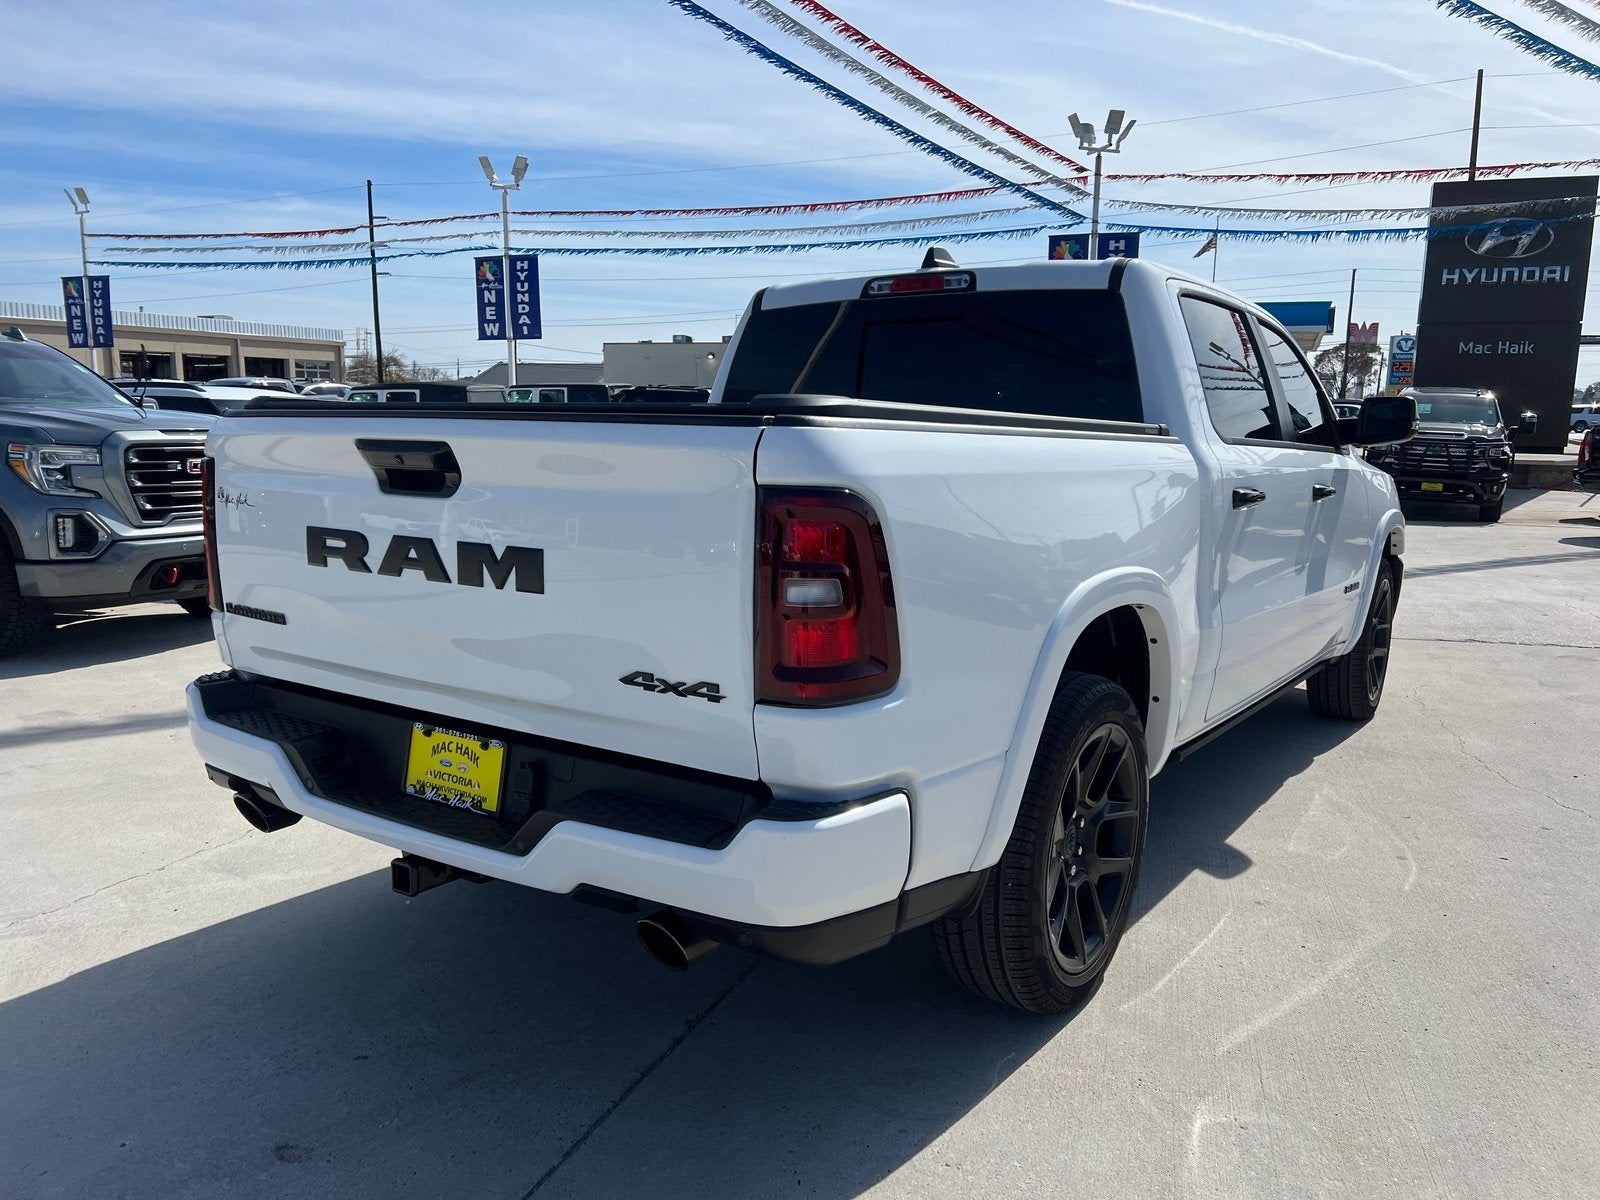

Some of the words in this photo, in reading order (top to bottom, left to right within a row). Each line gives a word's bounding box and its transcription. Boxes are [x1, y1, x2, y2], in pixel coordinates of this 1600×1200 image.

[1441, 265, 1571, 285] HYUNDAI
[93, 280, 105, 343] HYUNDAI
[484, 290, 499, 336] NEW
[516, 261, 531, 335] HYUNDAI
[70, 305, 83, 344] NEW
[1458, 341, 1492, 354] Mac
[1497, 340, 1534, 354] Haik
[306, 525, 545, 595] RAM
[431, 741, 453, 757] MAC
[456, 742, 480, 768] HAIK
[433, 770, 473, 788] VICTORIA
[424, 788, 448, 803] Mac
[448, 795, 488, 815] Haik
